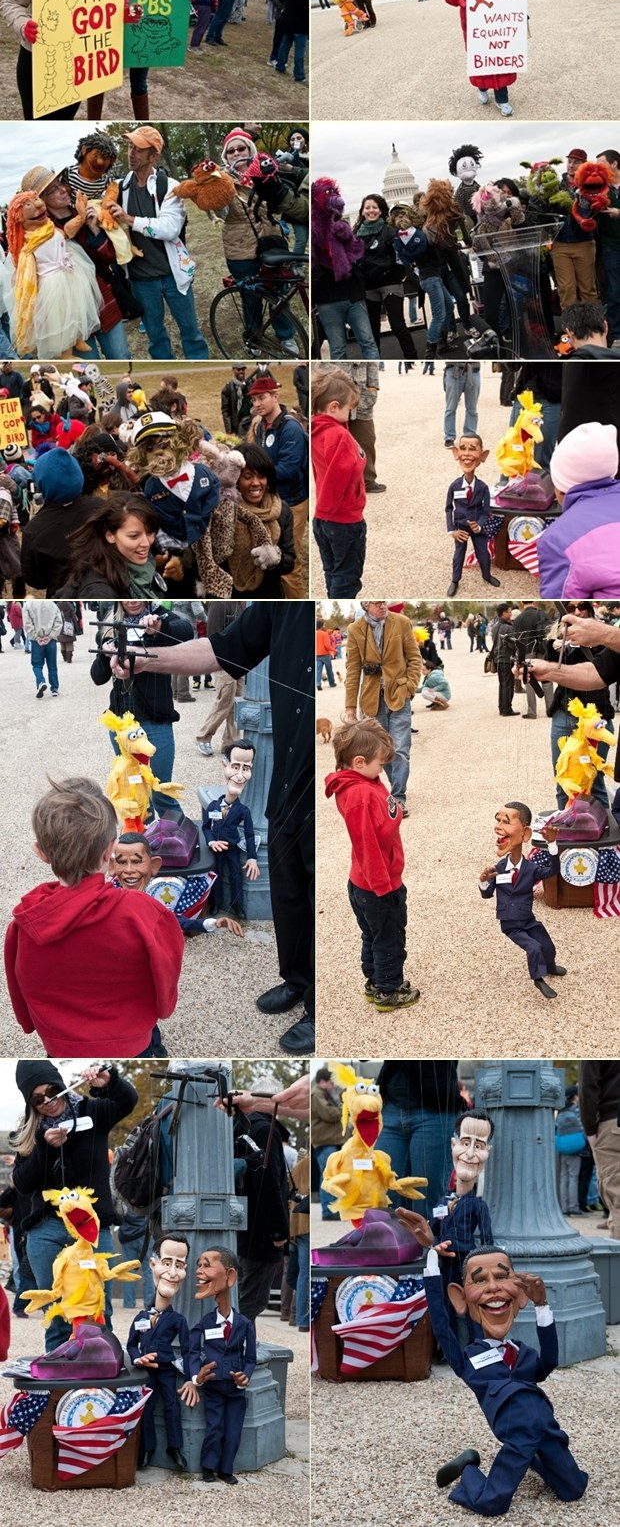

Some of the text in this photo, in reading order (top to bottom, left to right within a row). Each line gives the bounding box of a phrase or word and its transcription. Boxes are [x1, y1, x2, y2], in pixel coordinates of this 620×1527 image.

[72, 2, 117, 35] GOP
[483, 11, 524, 24] WANTS
[79, 31, 112, 52] THE
[488, 40, 510, 50] NOT
[0, 401, 18, 414] FLIP
[3, 418, 20, 429] GOP
[6, 432, 25, 444] BIRD
